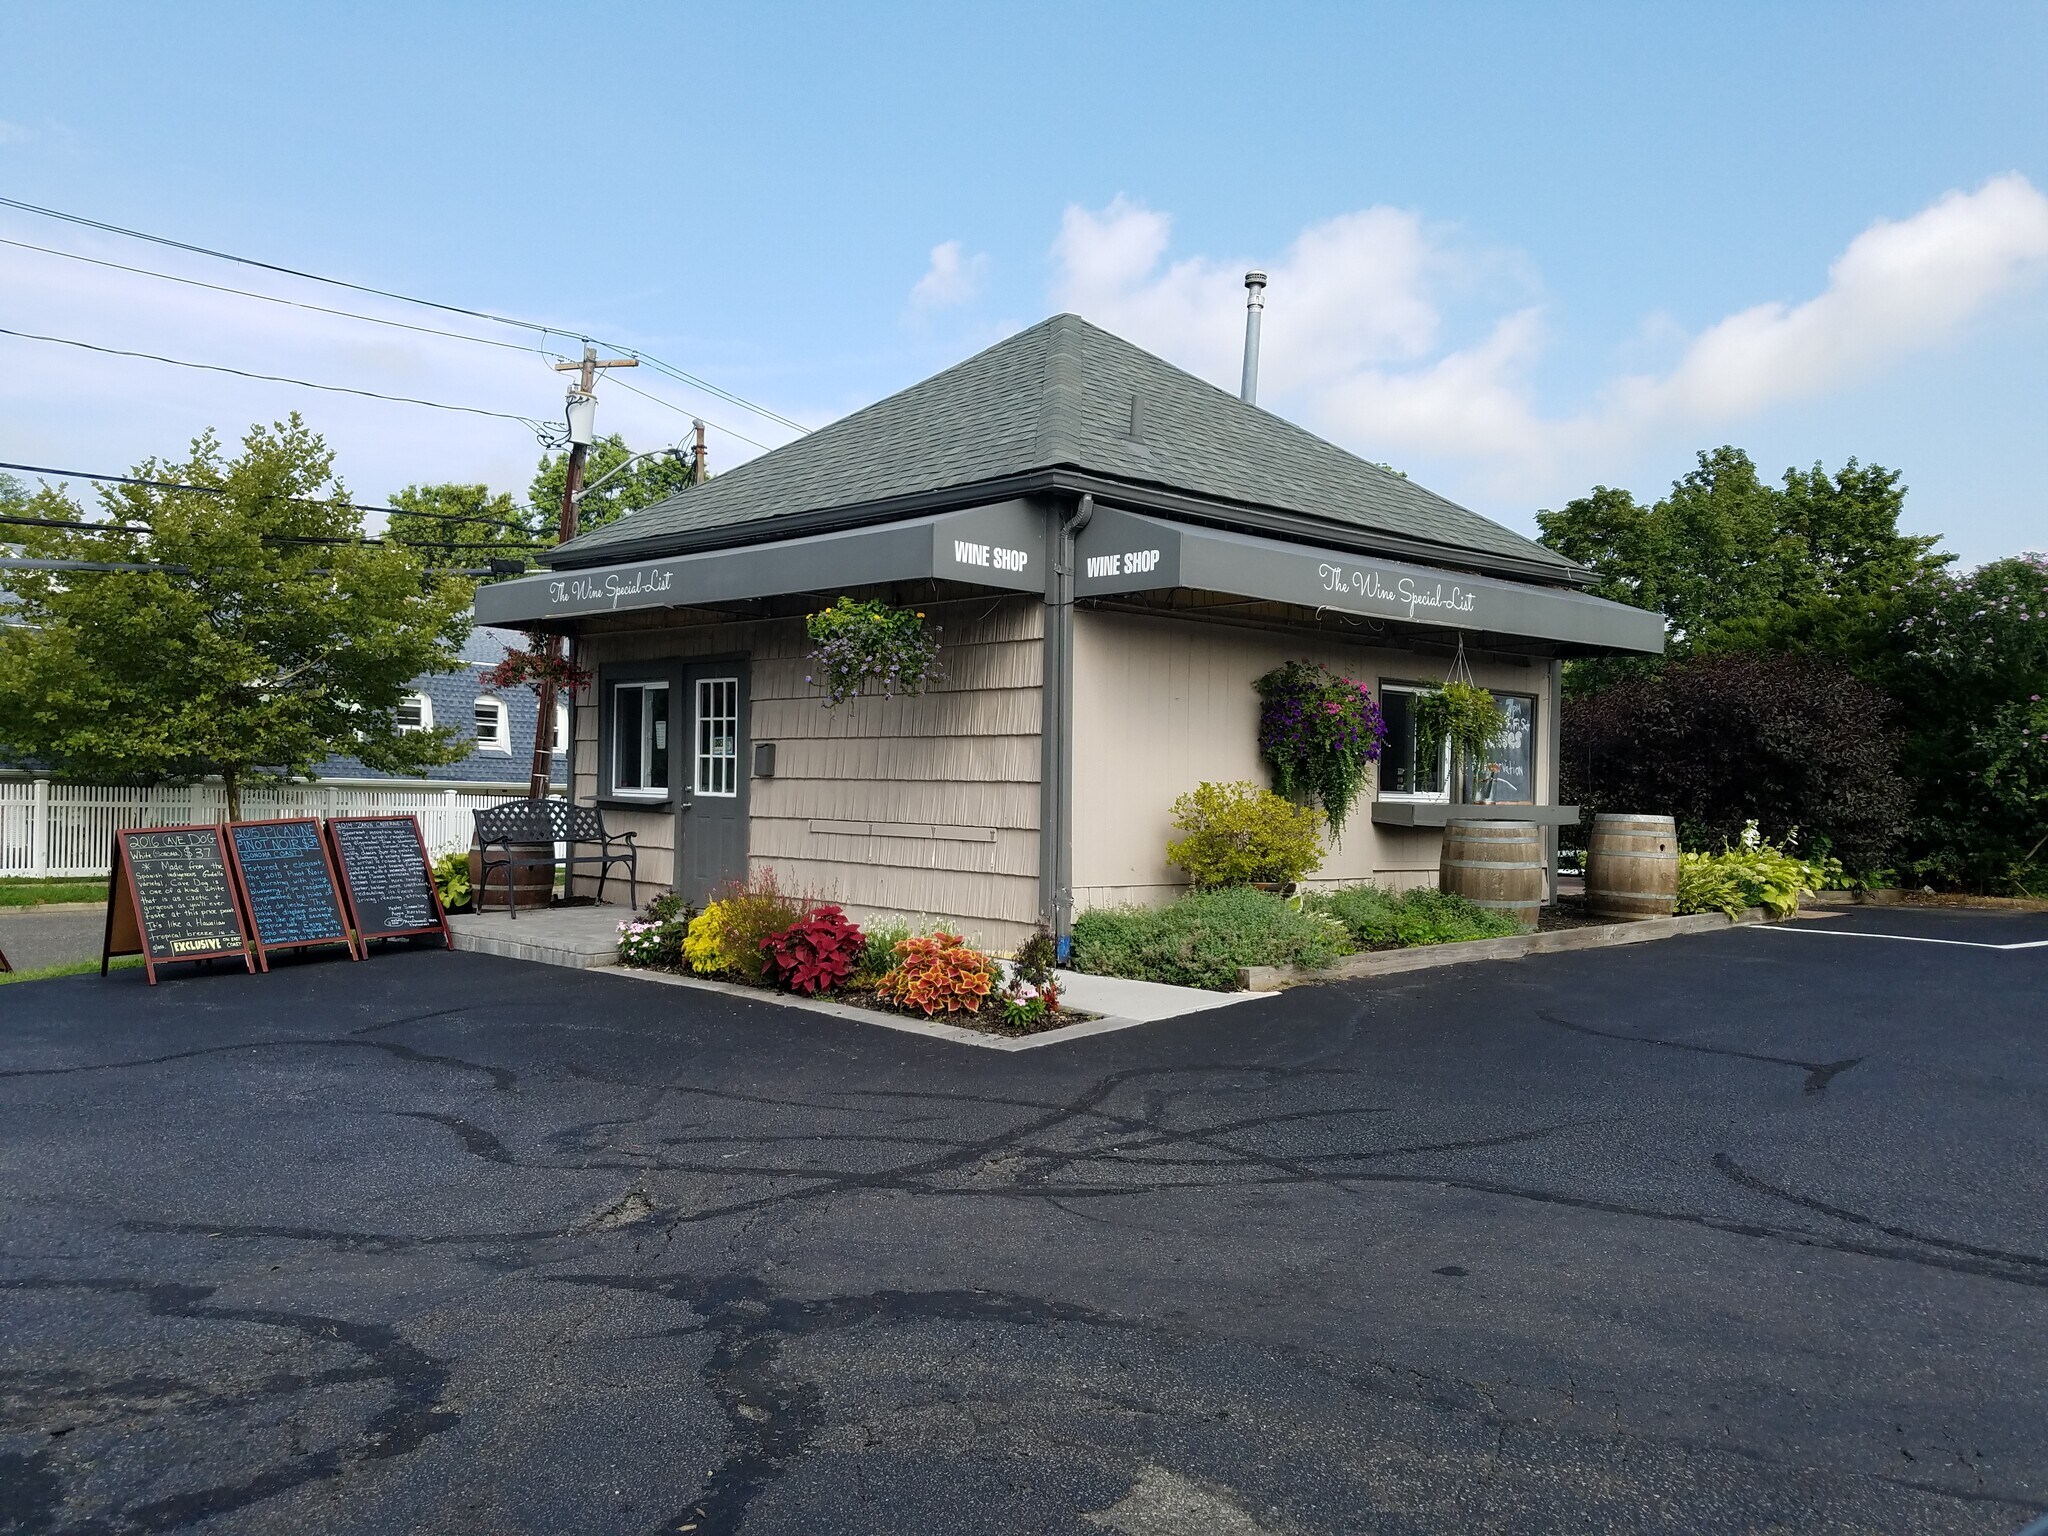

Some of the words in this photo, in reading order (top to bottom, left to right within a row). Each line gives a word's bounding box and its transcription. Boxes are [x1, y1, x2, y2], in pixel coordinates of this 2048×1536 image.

[954, 539, 990, 567] WINE
[993, 547, 1028, 572] SHOP
[1087, 554, 1121, 578] WINE
[1123, 549, 1160, 574] SHOP
[550, 581, 570, 603] The
[571, 576, 603, 600] Wine
[605, 569, 674, 609] Special-List
[1318, 563, 1350, 593] The
[1352, 571, 1396, 601] Wine
[1398, 578, 1476, 617] Special-List
[235, 827, 260, 839] 2015
[262, 824, 315, 840] PICAYUNE
[130, 836, 159, 848] 2016
[163, 835, 186, 847] CAVE
[188, 833, 216, 845] DOG
[236, 840, 267, 851] PINOT
[271, 839, 301, 850] NOIR
[302, 837, 319, 852] $39
[130, 850, 152, 860] White
[161, 861, 184, 871] Made
[189, 861, 204, 870] from
[211, 862, 224, 870] the
[242, 863, 279, 872] Textured
[136, 872, 163, 882] Spanish
[264, 872, 283, 880] 2015
[193, 878, 209, 887] Dog
[141, 896, 157, 905] that
[144, 904, 174, 914] gorgeous
[145, 912, 166, 920] taste
[201, 909, 217, 918] price
[145, 921, 162, 931] It's
[167, 920, 182, 928] like
[149, 932, 182, 942] tropical
[174, 938, 221, 952] EXCLUSIVE
